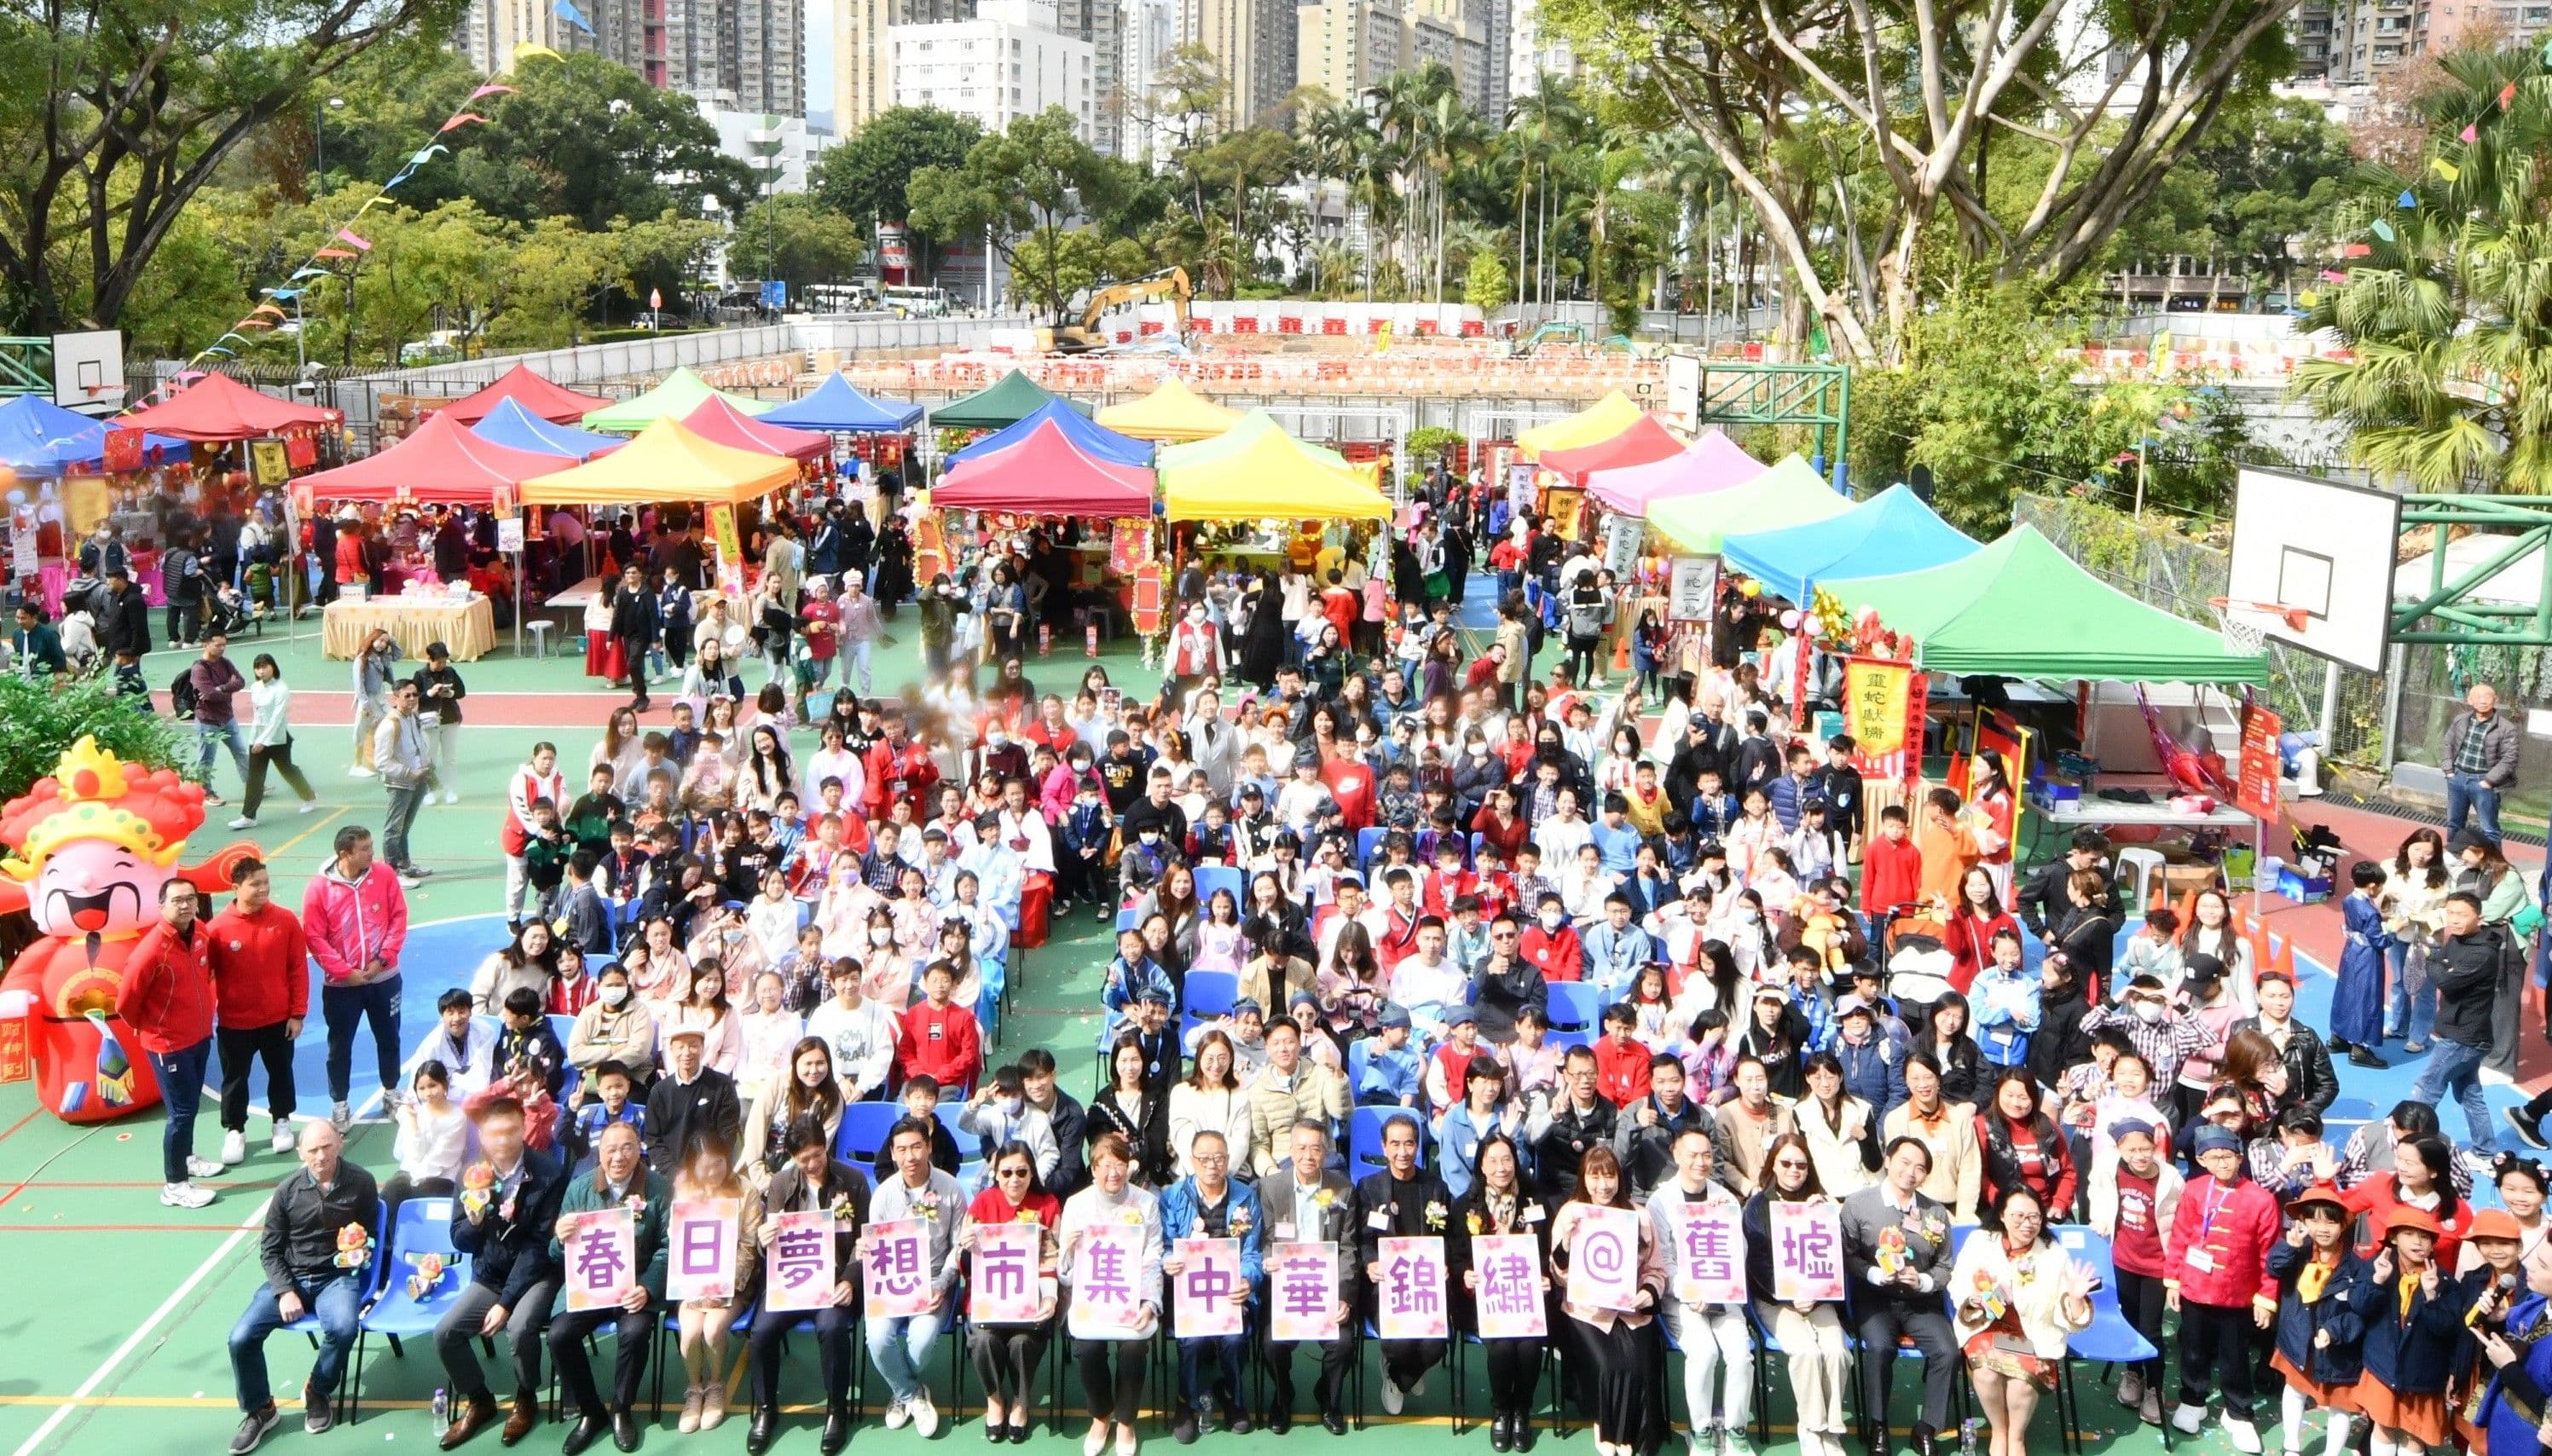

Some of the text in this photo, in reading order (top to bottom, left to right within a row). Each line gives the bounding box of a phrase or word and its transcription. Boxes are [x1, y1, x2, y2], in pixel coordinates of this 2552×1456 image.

[1862, 673, 1887, 740] 靈蛇獻瑞
[576, 1219, 1834, 1318] 春 日 夢 想 市 集 中 華 錦 繡 @ 舊 墟
